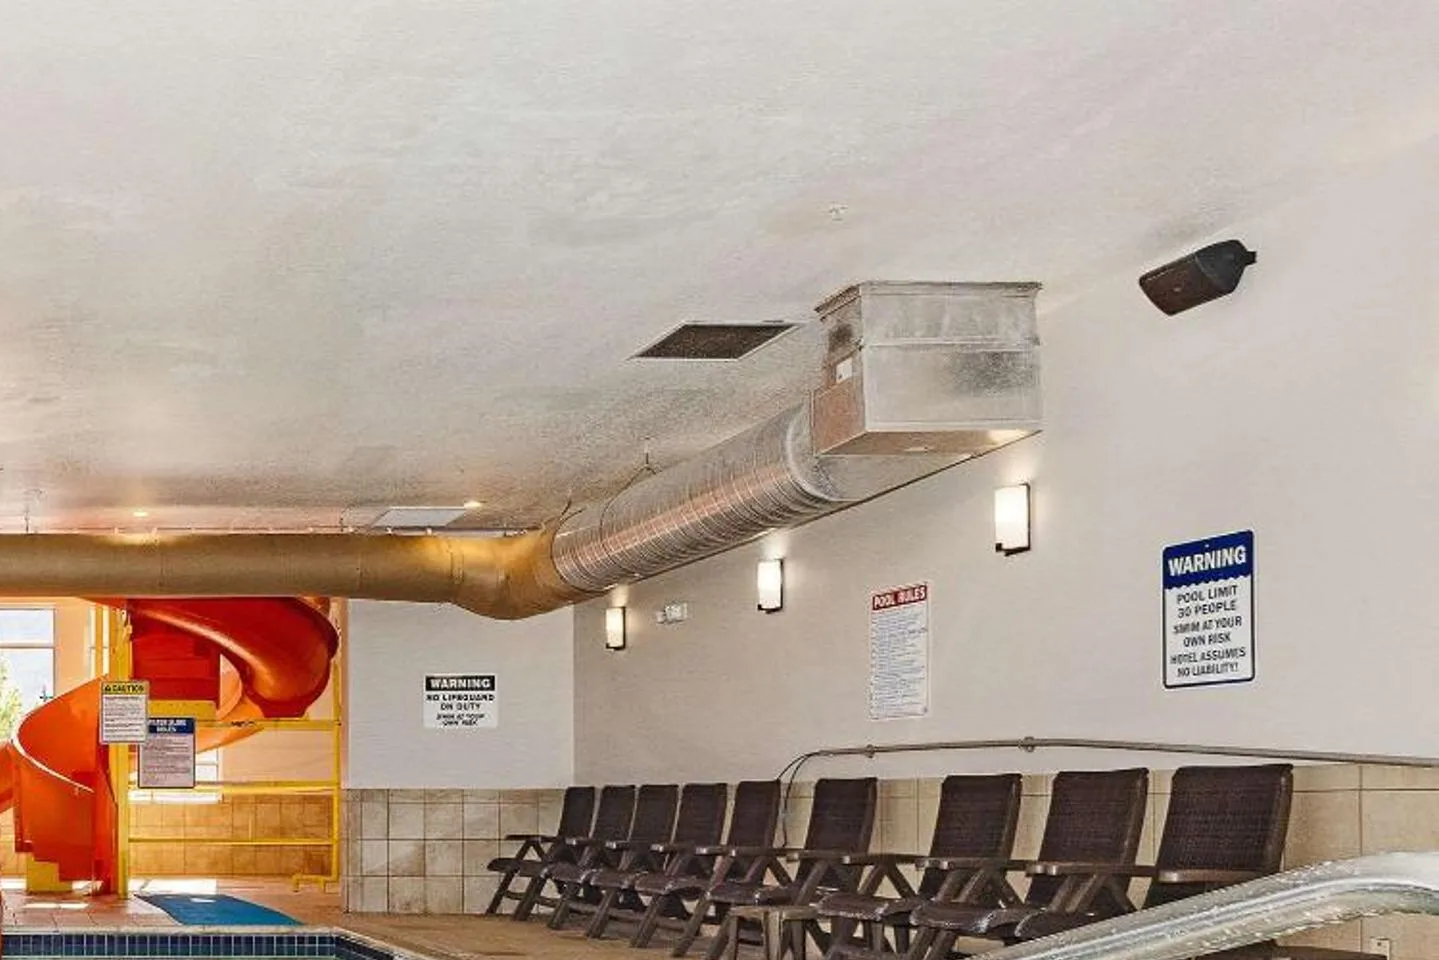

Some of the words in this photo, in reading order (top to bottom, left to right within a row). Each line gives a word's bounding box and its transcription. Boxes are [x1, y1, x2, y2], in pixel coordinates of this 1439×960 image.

[1168, 545, 1246, 576] WARNING
[1176, 590, 1205, 604] POOL
[1208, 585, 1238, 599] LIMIT
[1177, 607, 1192, 618] 30
[1195, 600, 1237, 616] PEOPLE
[1173, 622, 1200, 634] SWIM
[1202, 619, 1213, 631] AT
[1214, 616, 1242, 628] YOUR
[1183, 636, 1206, 647] OWN
[1208, 633, 1231, 645] RISK
[1170, 652, 1197, 665] HOTEL
[1200, 647, 1246, 662] ASSUMES
[1177, 665, 1190, 677] NO
[430, 678, 491, 689] WARNING
[440, 702, 453, 711] ON
[456, 702, 481, 711] DUTY
